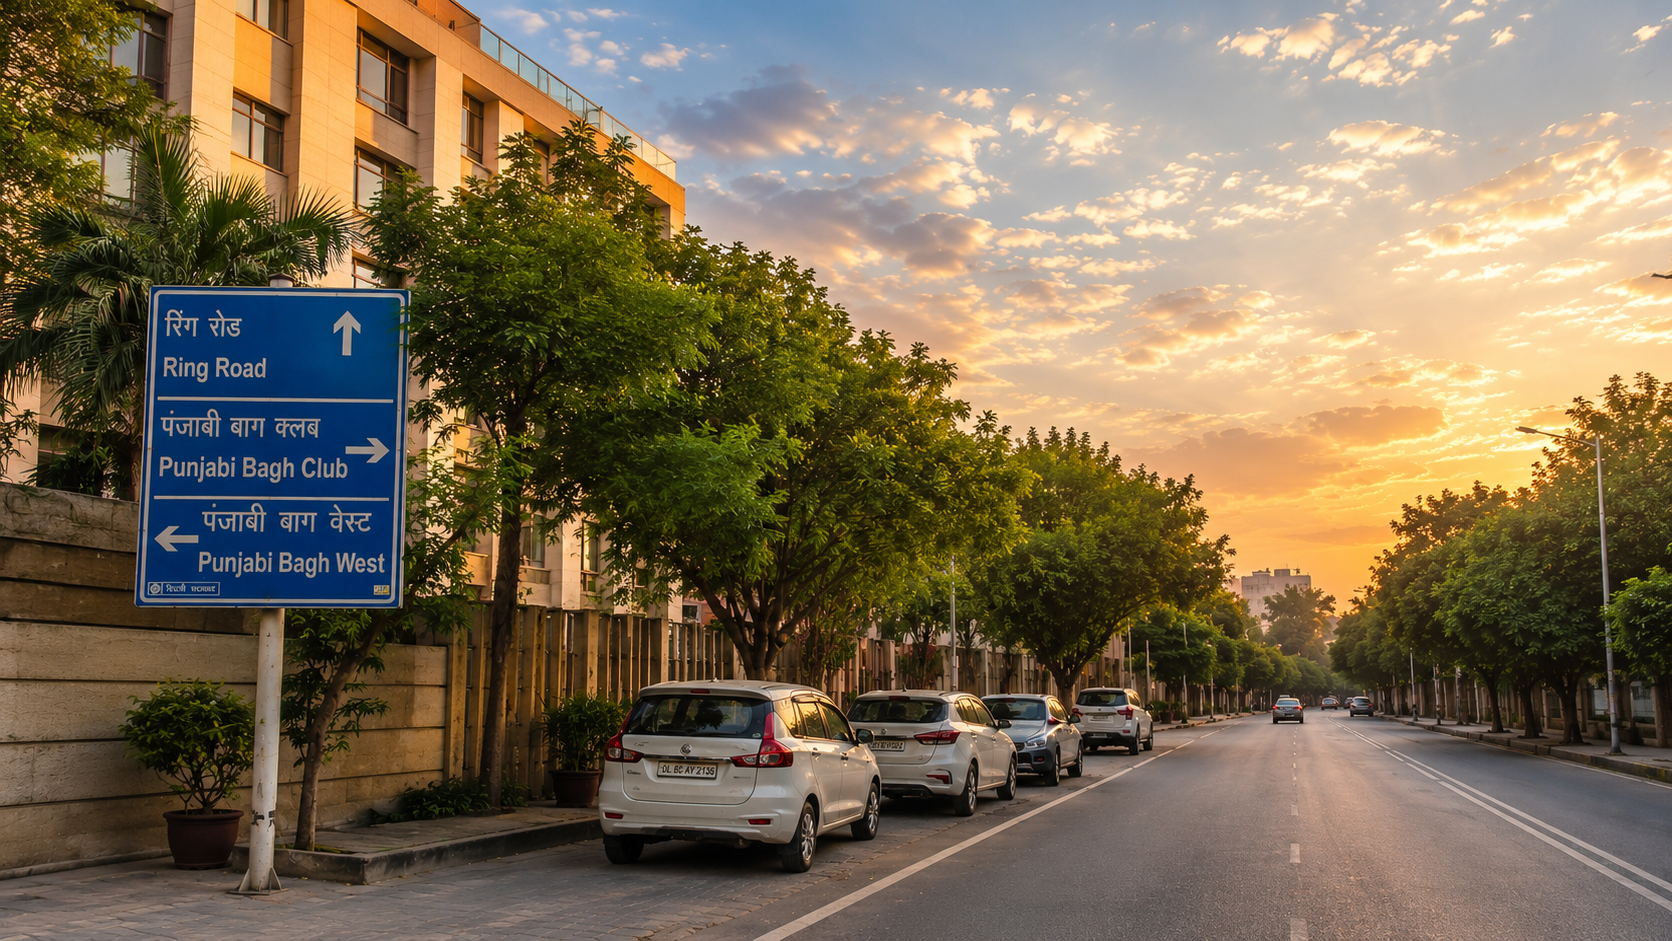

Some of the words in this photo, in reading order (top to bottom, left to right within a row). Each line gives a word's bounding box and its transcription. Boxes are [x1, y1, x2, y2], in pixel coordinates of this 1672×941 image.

[165, 309, 199, 337] रिंग
[208, 310, 242, 337] रोड
[163, 357, 208, 382] Ring
[215, 358, 267, 378] Road
[160, 409, 221, 437] पंजाबी
[230, 418, 265, 437] बाग
[275, 418, 321, 438] क्लब
[159, 456, 236, 482] Punjabi
[243, 457, 294, 483] Bagh
[301, 458, 348, 478] Club
[202, 503, 266, 532] पंजाबी
[279, 511, 317, 532] बाग
[329, 504, 372, 532] वेस्ट
[199, 552, 272, 577] Punjabi
[279, 552, 329, 578] Bagh
[336, 553, 385, 573] West
